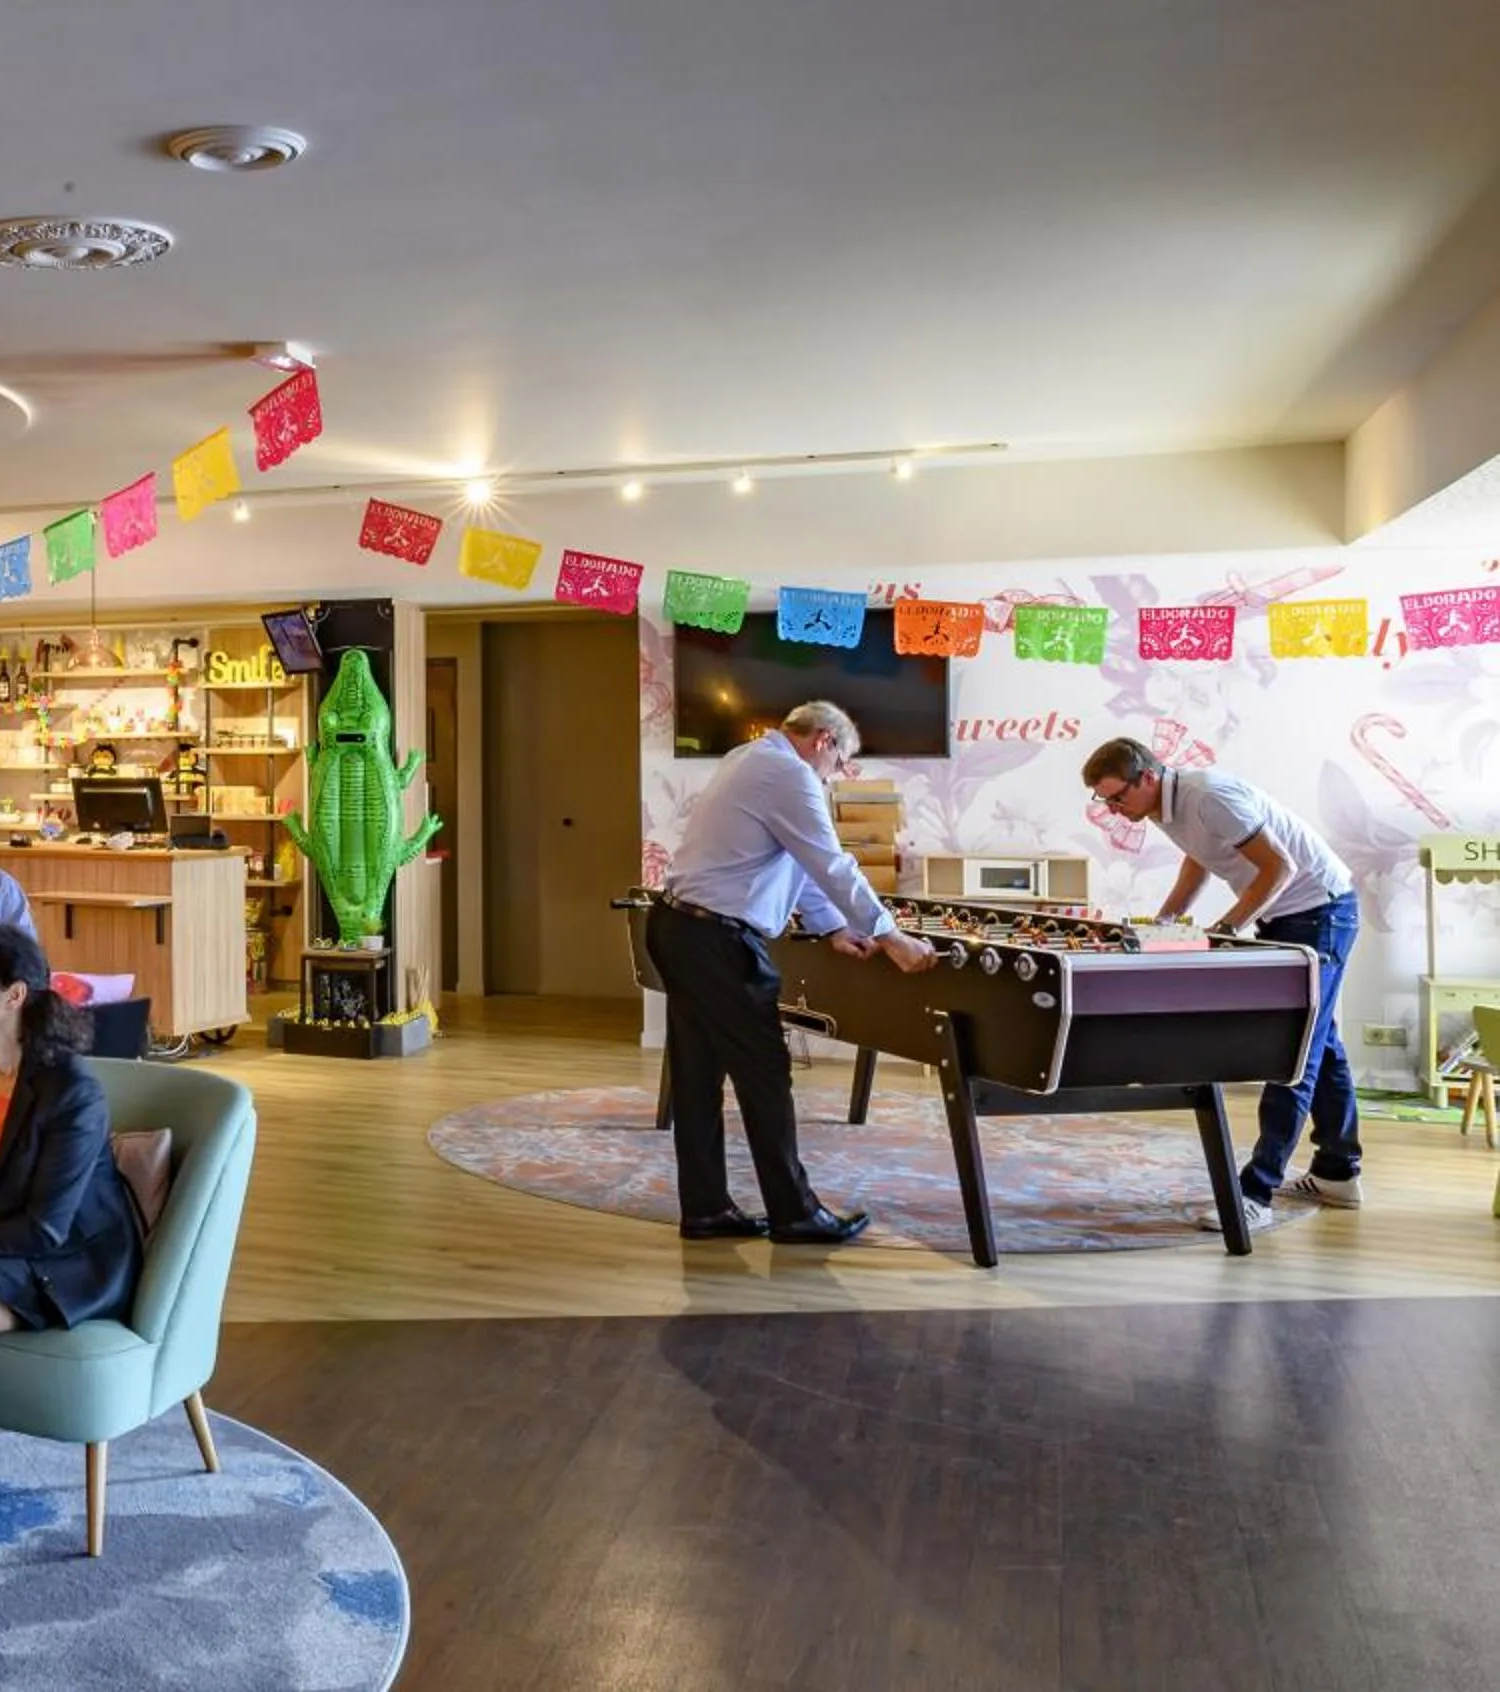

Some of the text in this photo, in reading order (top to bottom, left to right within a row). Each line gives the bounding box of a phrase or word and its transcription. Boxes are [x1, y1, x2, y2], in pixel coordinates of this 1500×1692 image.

[564, 554, 638, 577] ELDORADO
[1404, 589, 1497, 610] ELDORADO
[1141, 608, 1229, 620] ELDORADO
[951, 710, 1082, 742] weets
